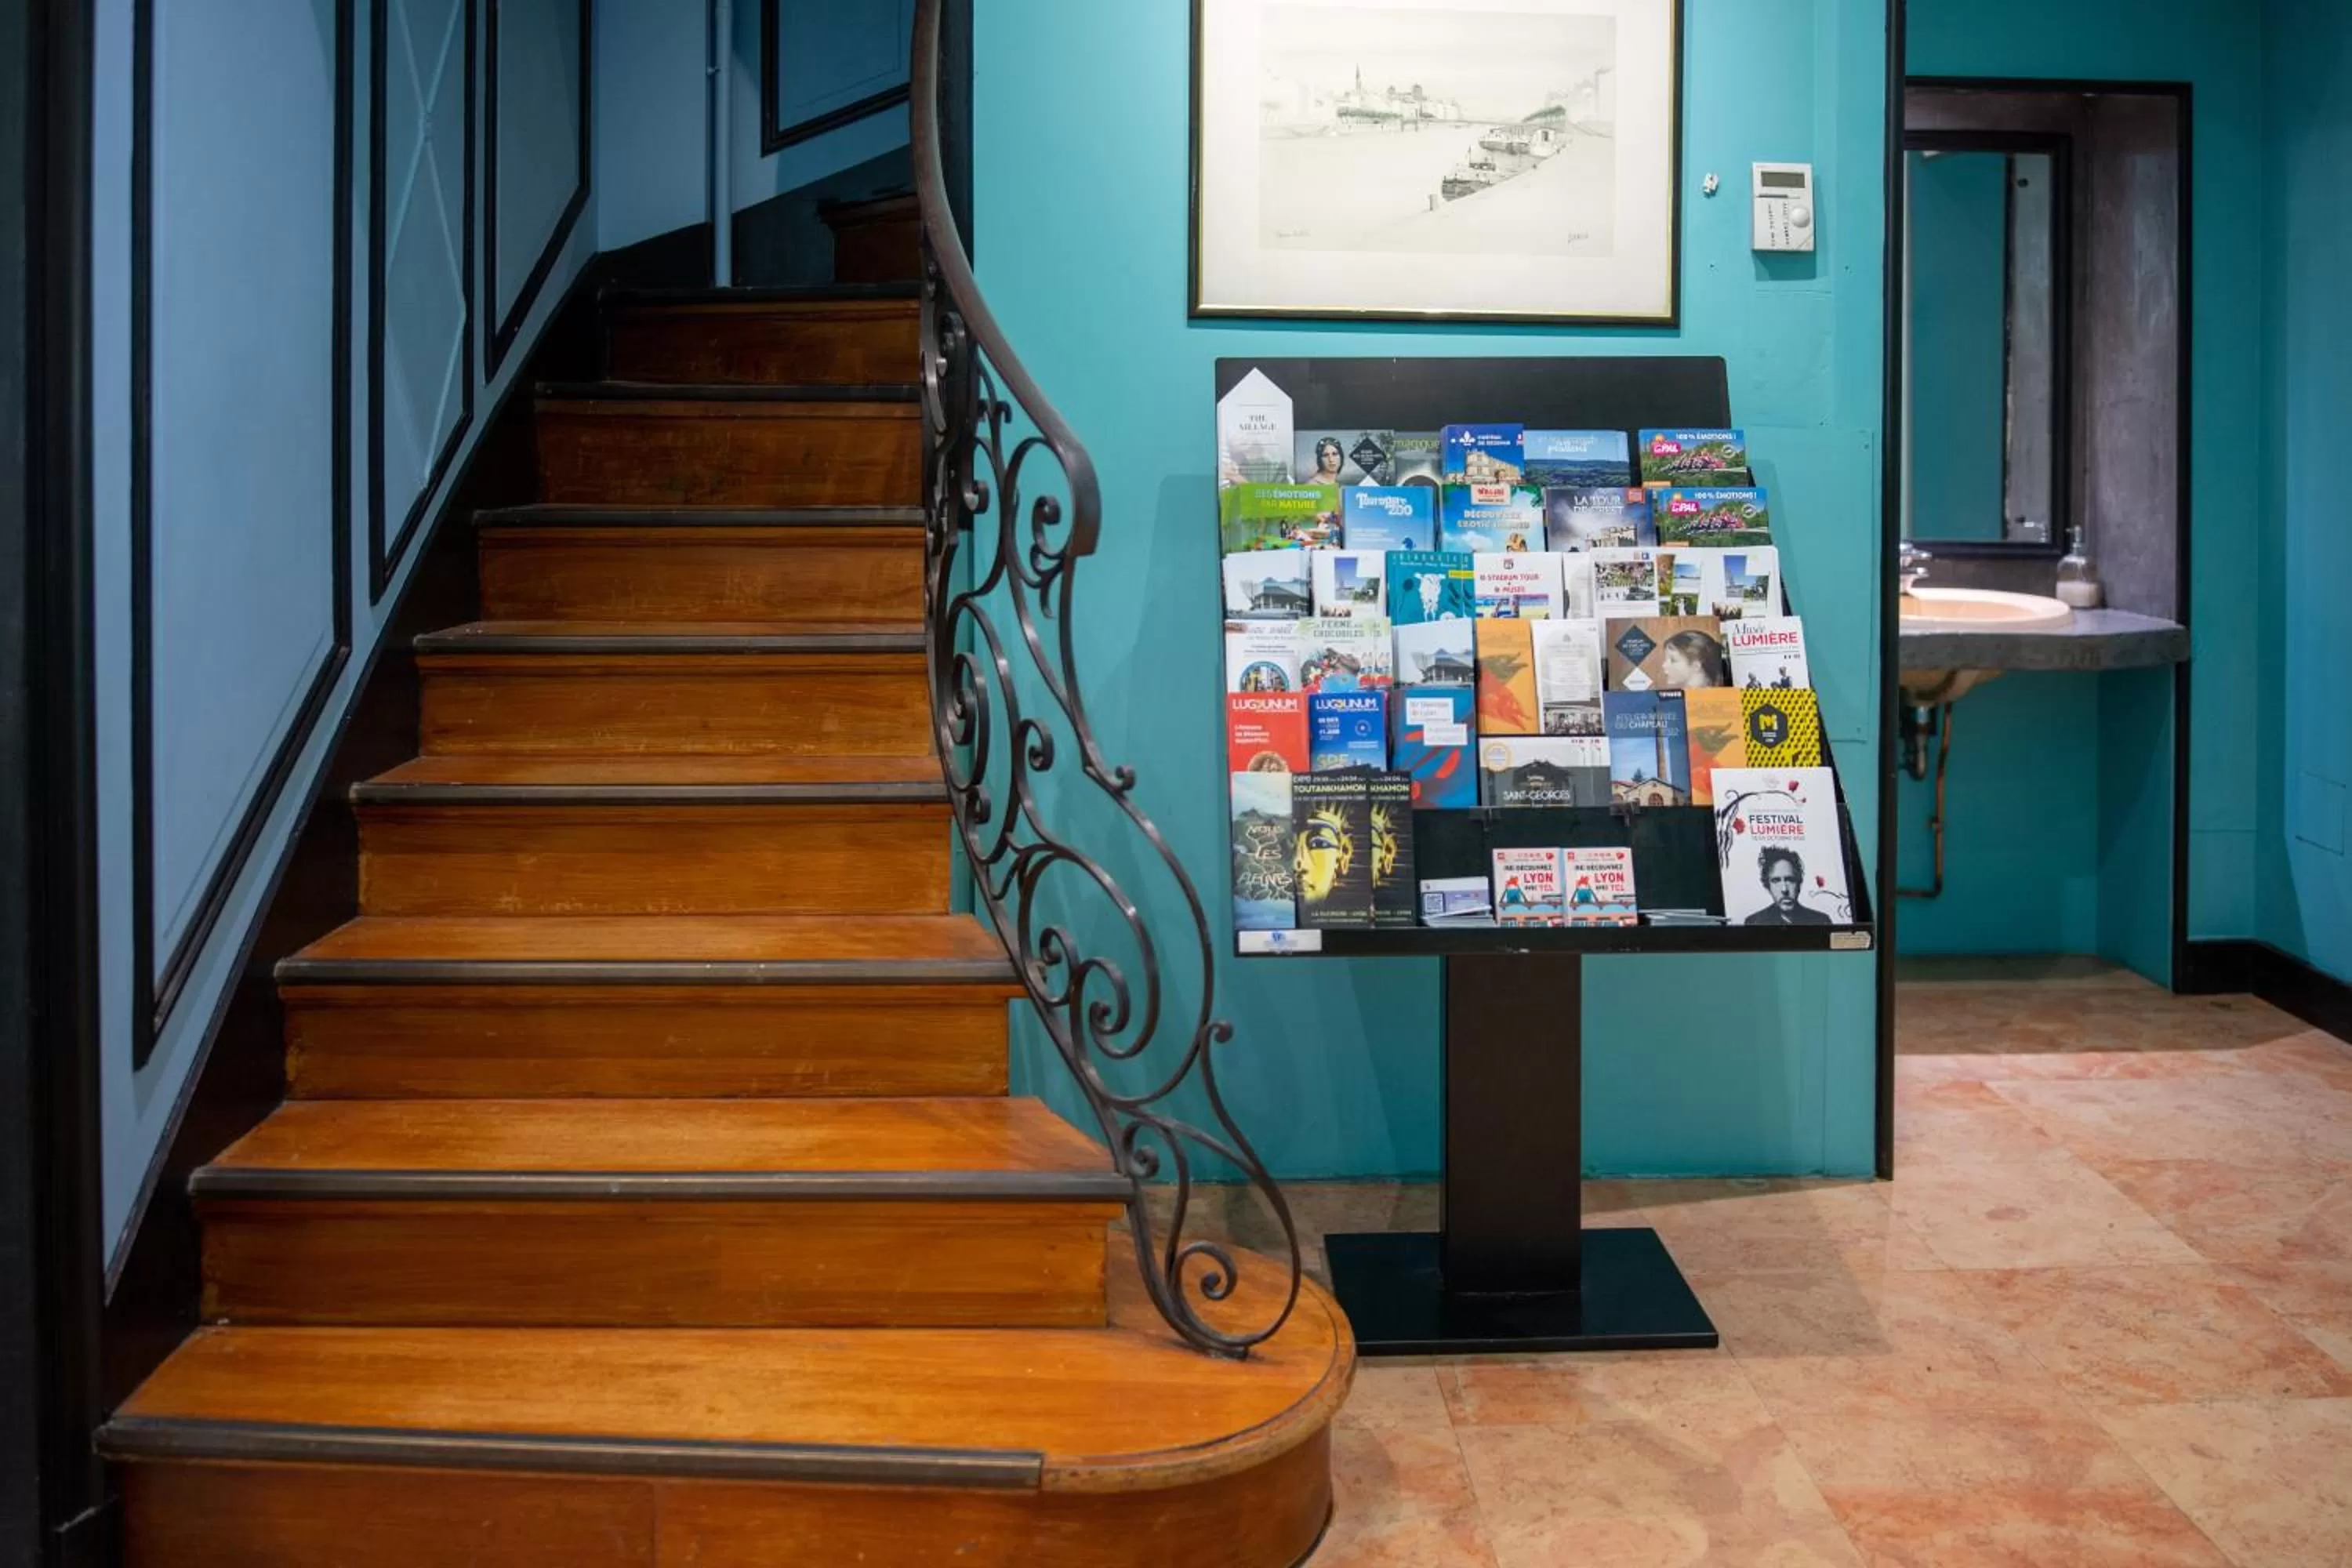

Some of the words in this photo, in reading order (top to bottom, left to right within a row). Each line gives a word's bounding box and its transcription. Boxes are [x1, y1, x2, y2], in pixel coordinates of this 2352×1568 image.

[1574, 495, 1588, 505] LA
[1591, 495, 1621, 505] TOUR
[1733, 630, 1798, 647] LUMIÈRE
[1502, 790, 1570, 800] SAINT-GEORGES
[1749, 815, 1804, 823] FESTIVAL
[1751, 824, 1805, 834] LUMIÈRE
[1524, 873, 1553, 883] LYON
[1595, 873, 1624, 882] LYON
